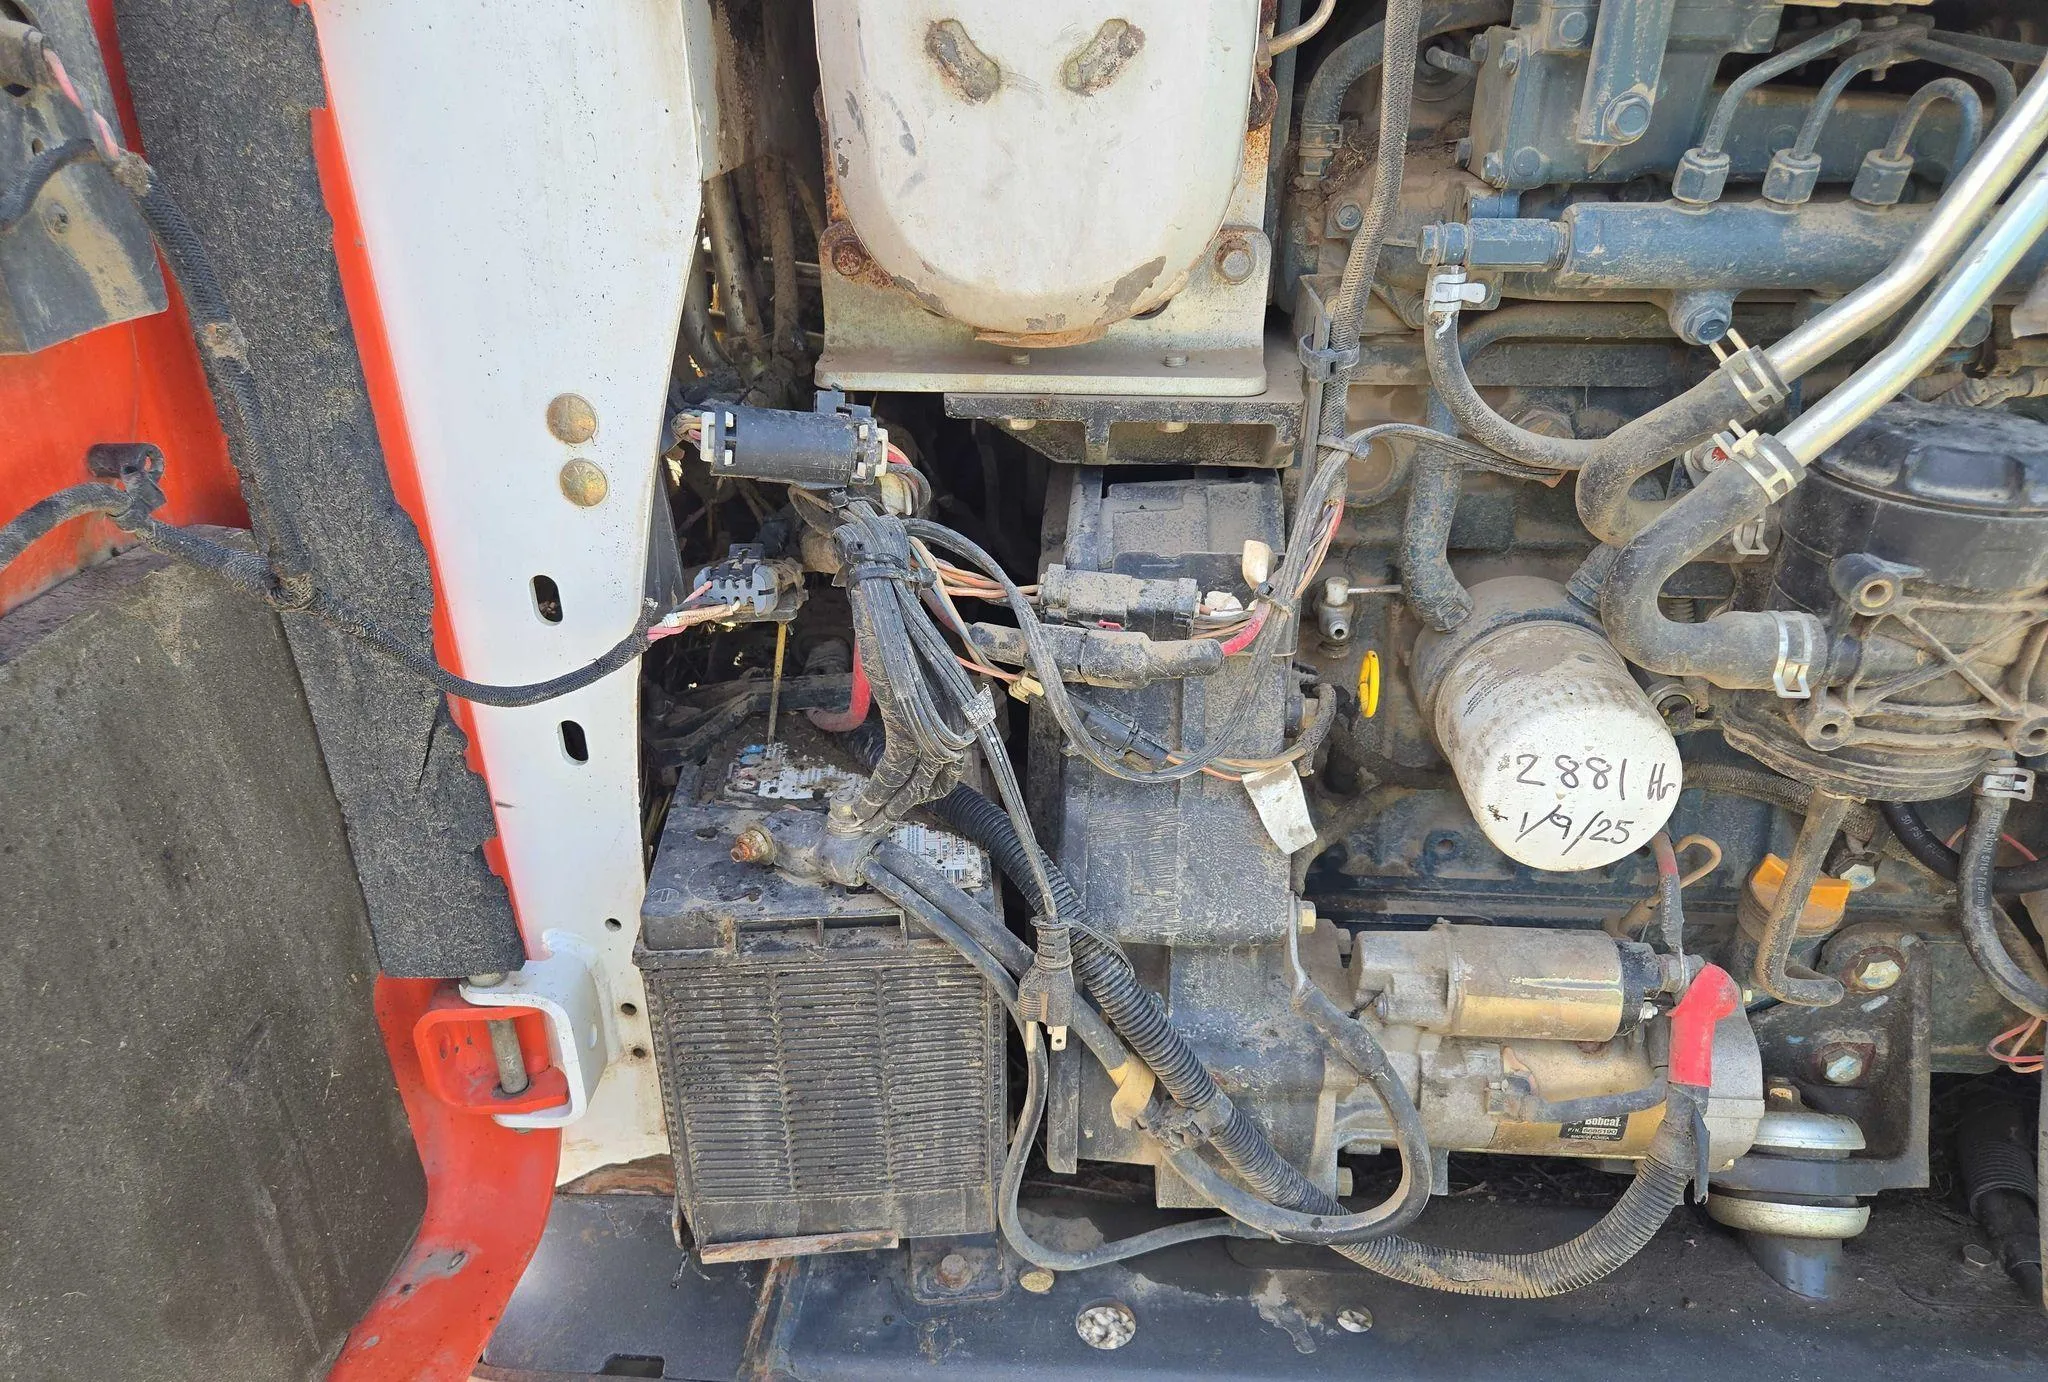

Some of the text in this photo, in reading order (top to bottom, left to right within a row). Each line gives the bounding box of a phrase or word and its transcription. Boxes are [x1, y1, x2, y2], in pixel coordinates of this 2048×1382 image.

[1516, 754, 1627, 800] 2881
[1514, 804, 1635, 856] 1/9/25
[1585, 1116, 1620, 1127] Bobcat
